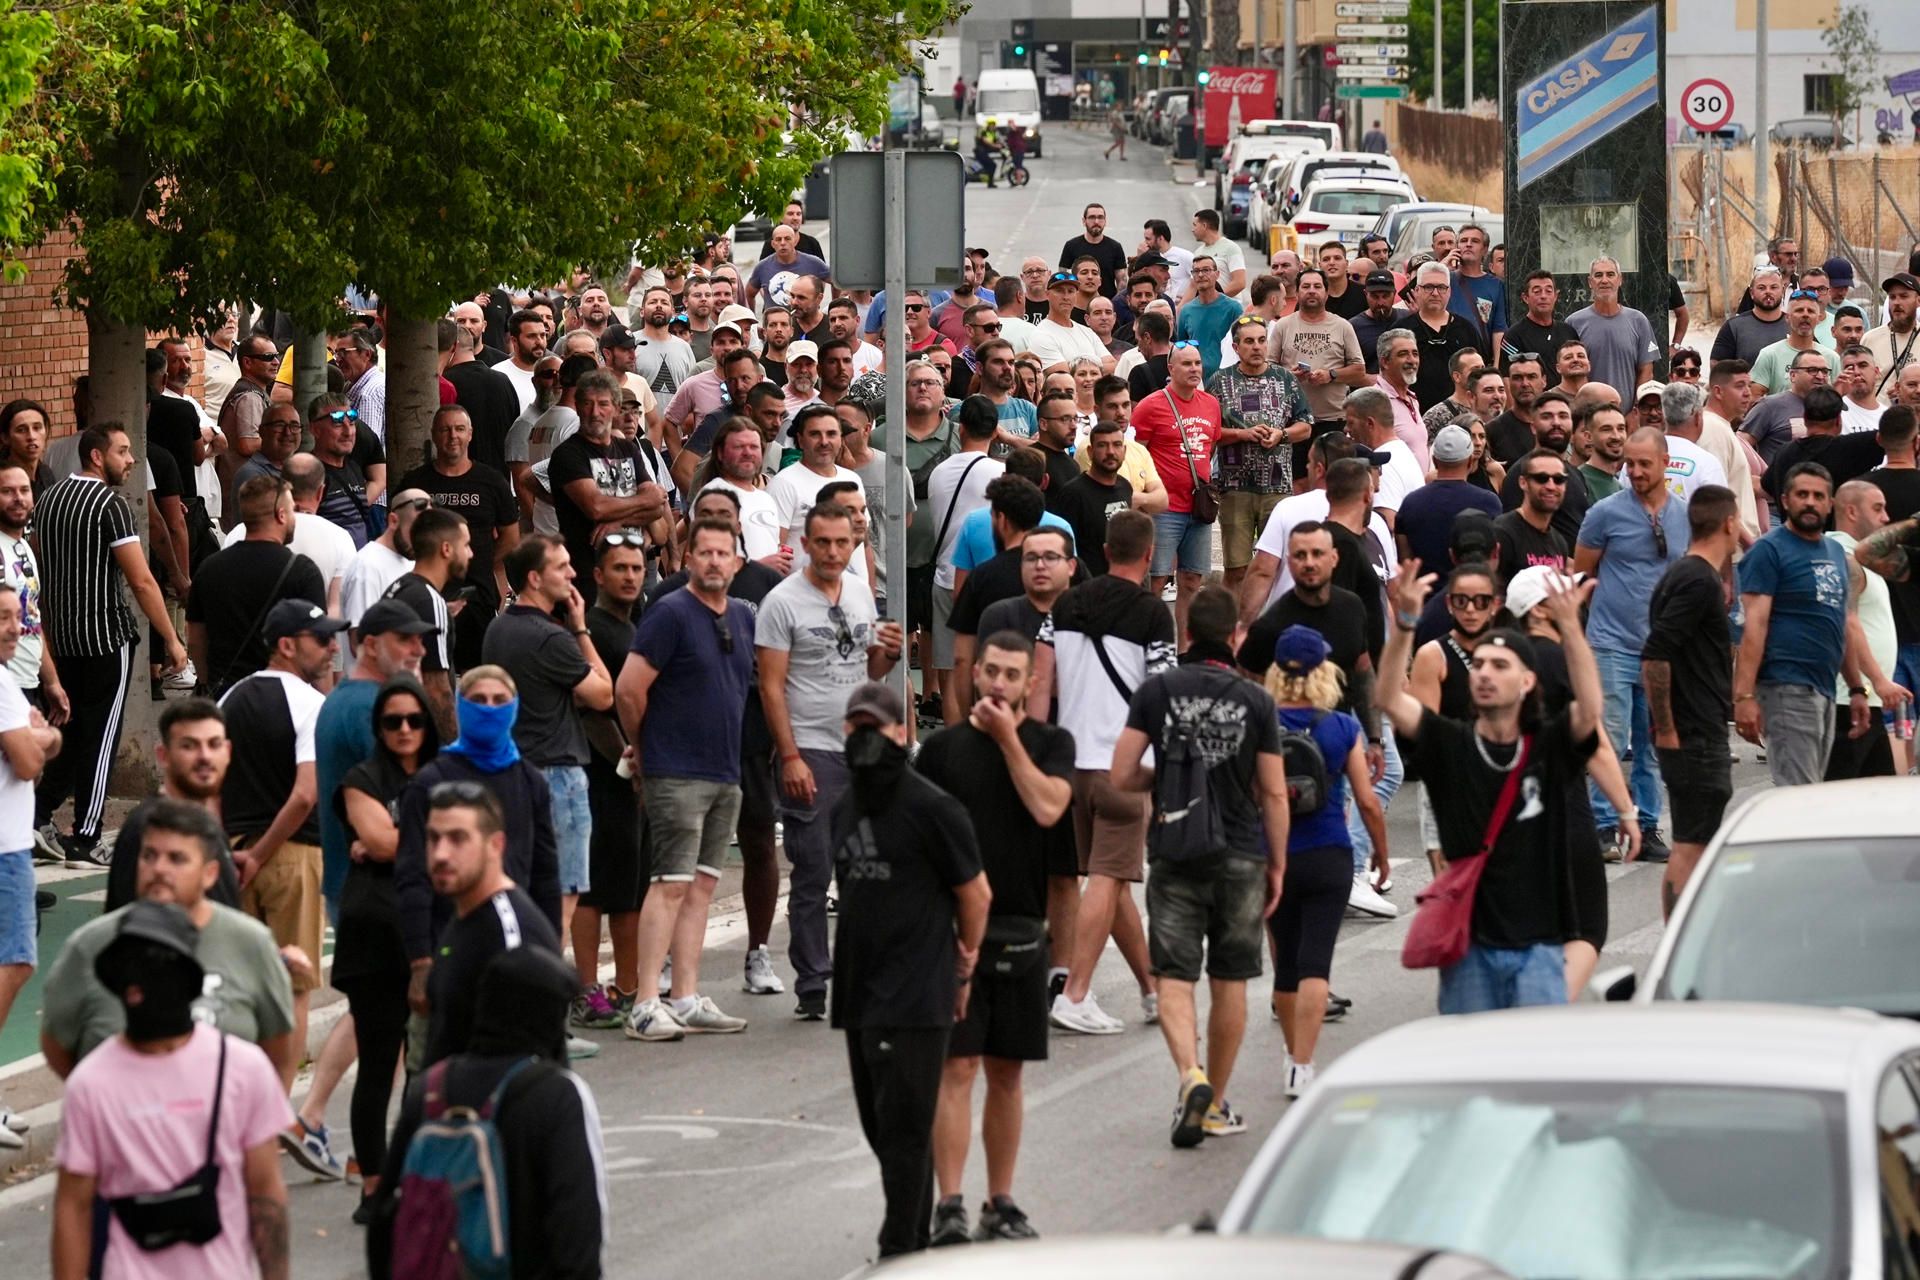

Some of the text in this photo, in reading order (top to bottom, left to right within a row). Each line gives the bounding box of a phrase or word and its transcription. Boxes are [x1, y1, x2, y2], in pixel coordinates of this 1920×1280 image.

[1527, 58, 1602, 114] CASA
[1693, 96, 1722, 112] 30
[1294, 332, 1331, 344] ADVENTURE
[1293, 344, 1332, 355] AWAITS
